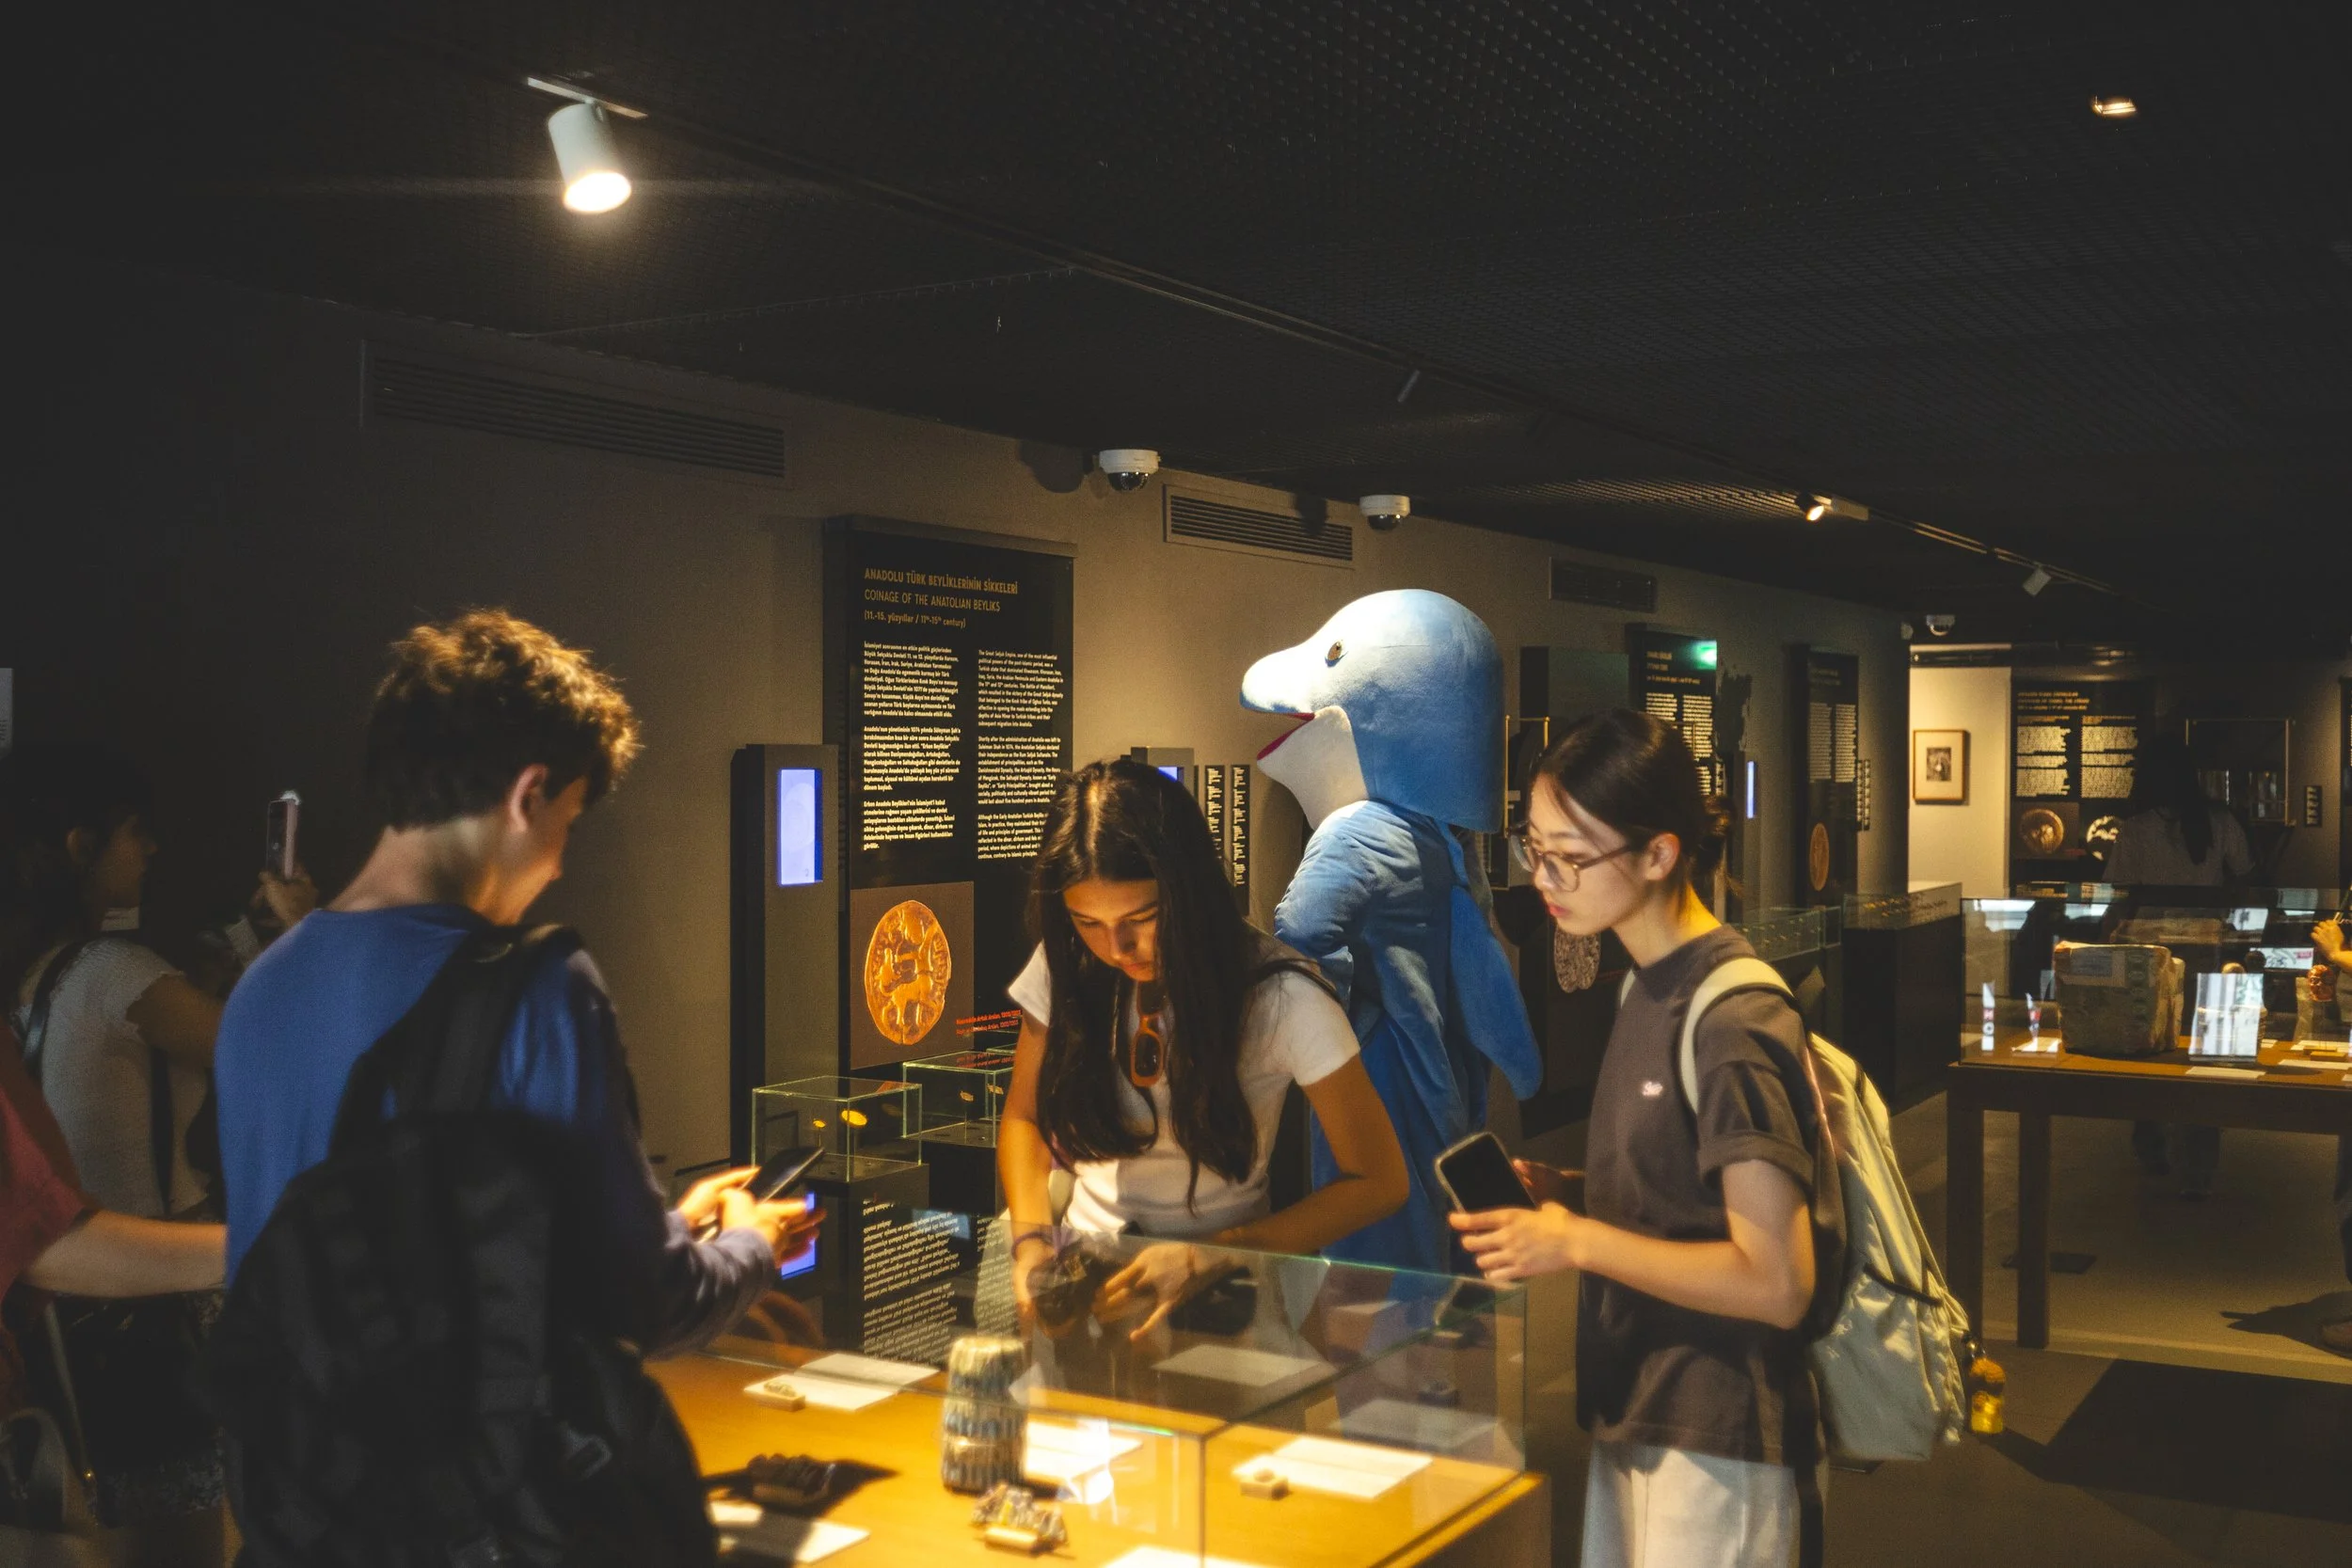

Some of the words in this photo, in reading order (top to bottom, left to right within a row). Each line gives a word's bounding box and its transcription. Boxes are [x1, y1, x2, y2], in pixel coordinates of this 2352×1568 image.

[865, 568, 903, 583] ANADOLU
[907, 570, 926, 585] TÜRK
[929, 574, 982, 591] BEYLİKLERİNİN
[983, 578, 1018, 594] SİKKELERİ
[865, 589, 898, 603] COINAGE
[902, 593, 912, 604] OF
[914, 594, 928, 606] THE
[930, 595, 971, 610] ANATOLIAN
[974, 599, 1000, 611] BEYLIKS
[943, 618, 966, 628] century)
